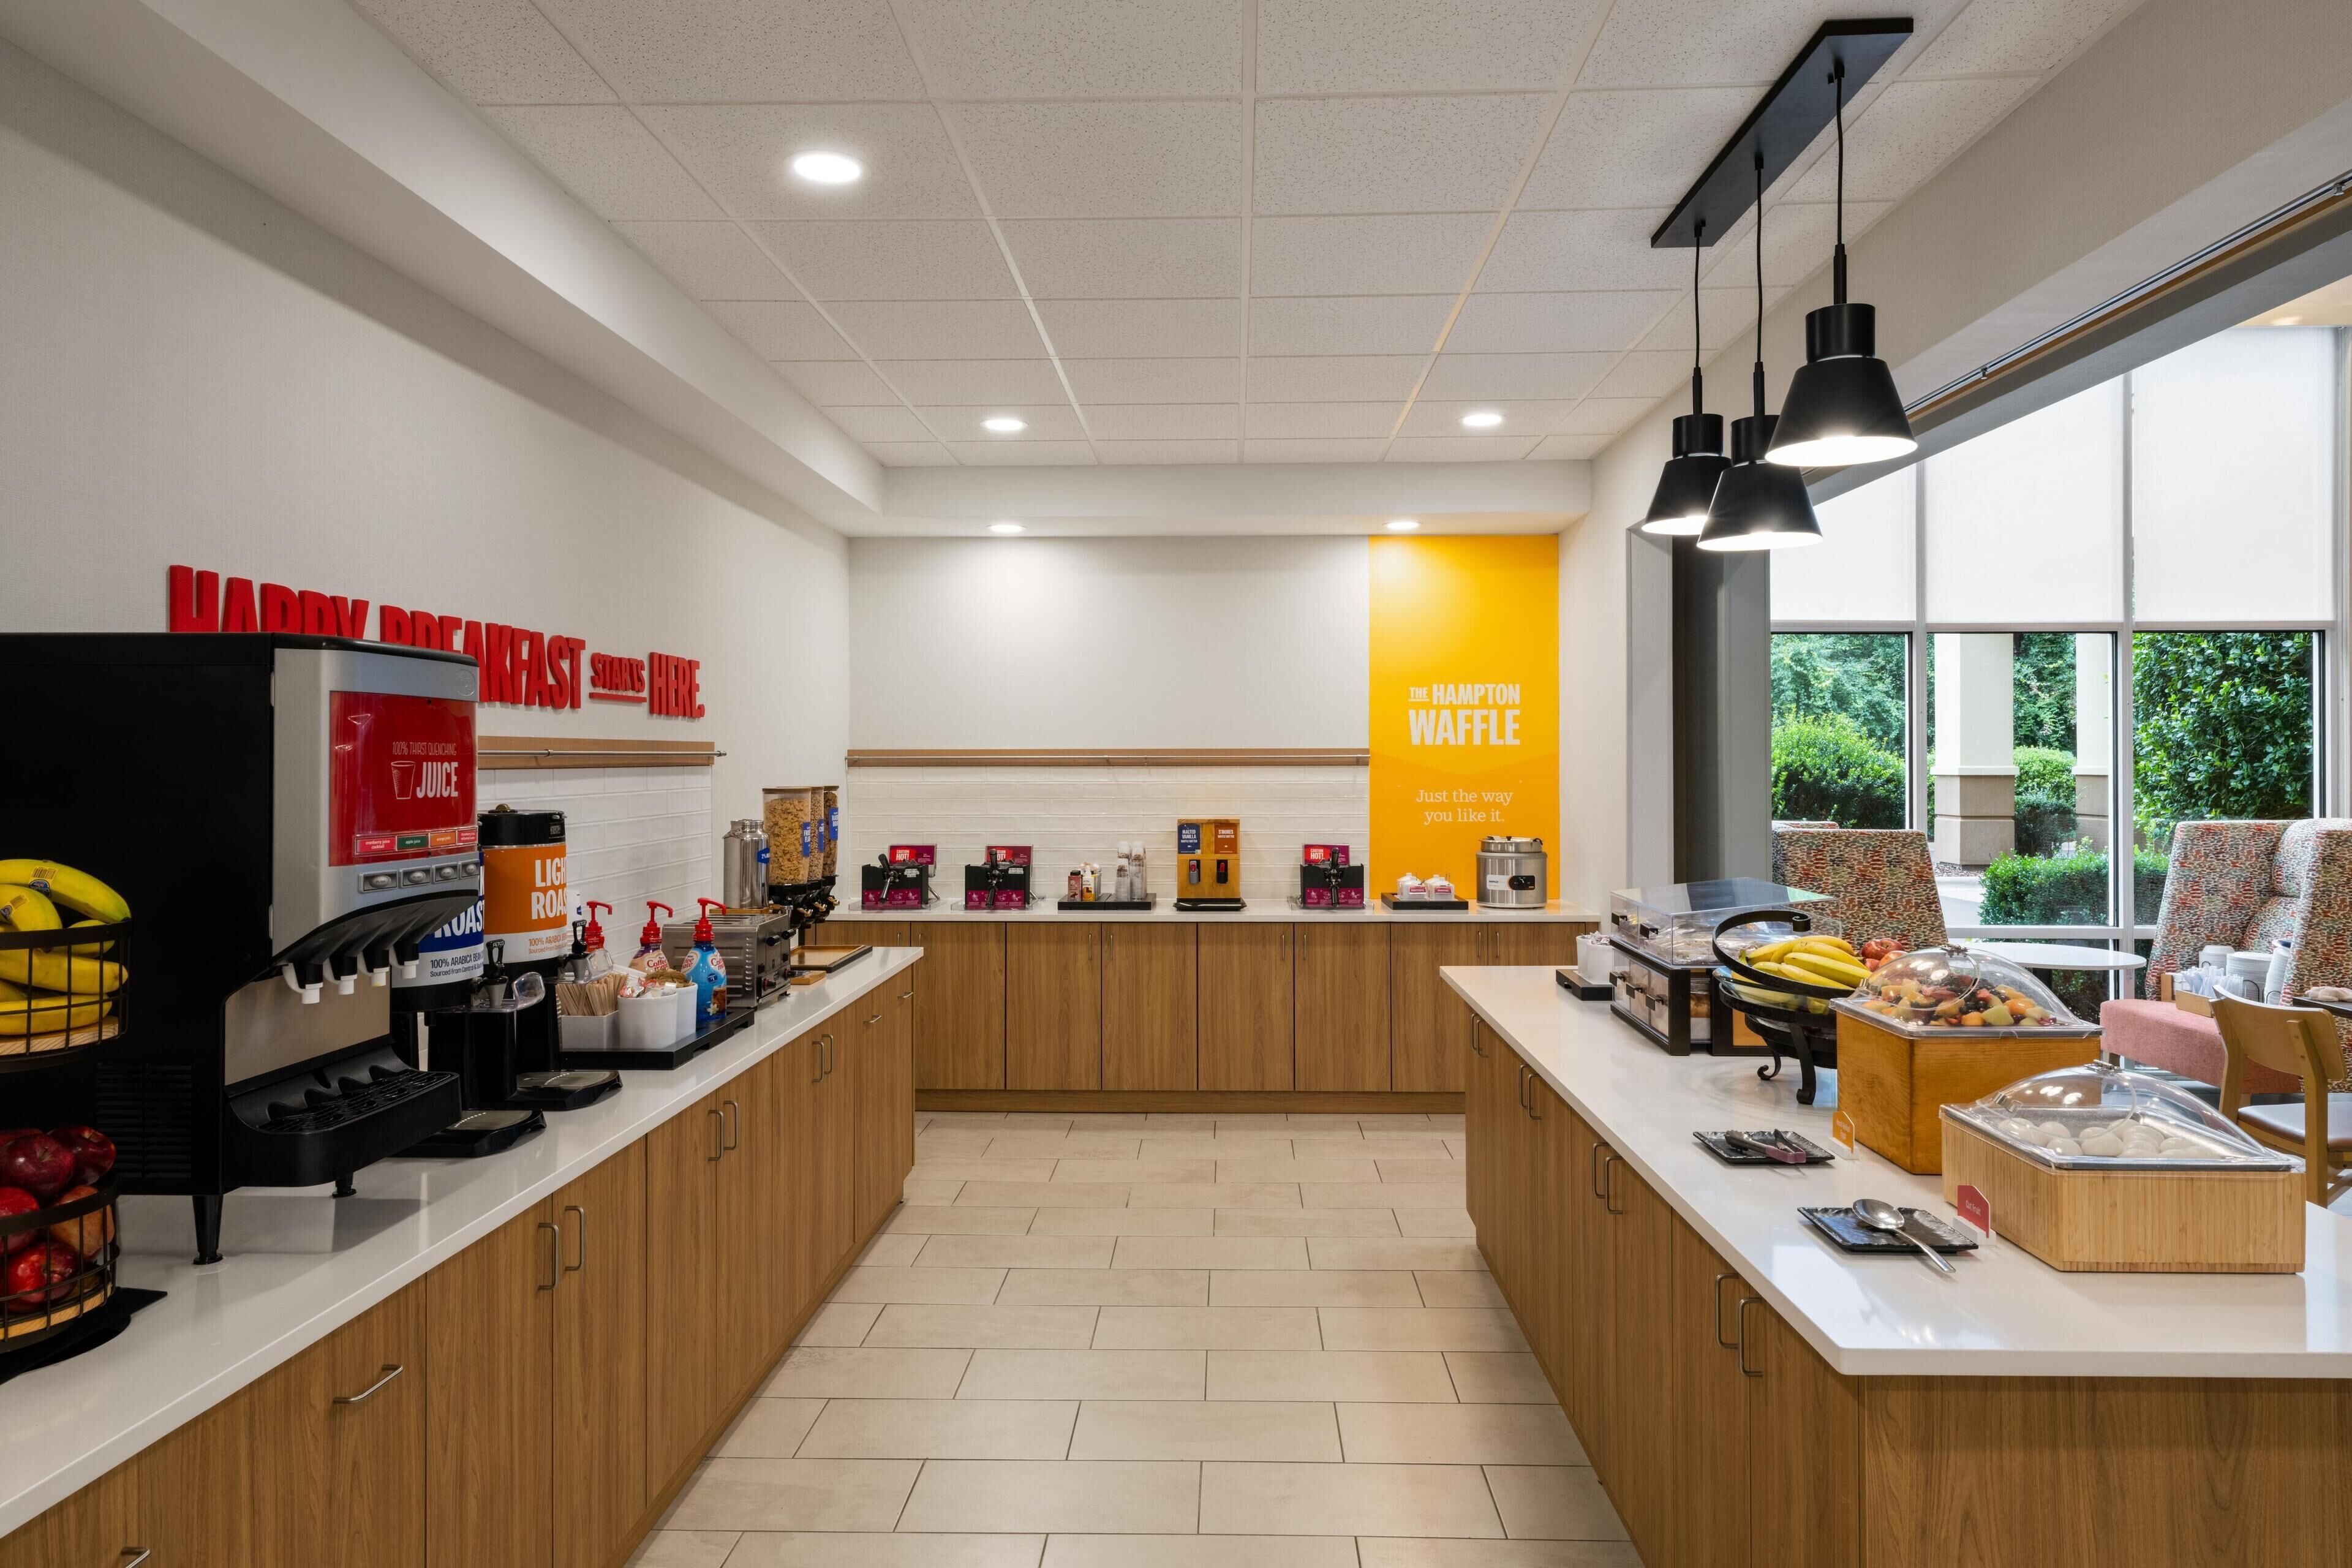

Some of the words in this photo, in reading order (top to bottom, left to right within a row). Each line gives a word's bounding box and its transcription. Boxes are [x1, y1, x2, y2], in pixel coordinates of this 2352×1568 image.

[590, 652, 646, 693] STARTS
[649, 652, 706, 718] HERE.
[1409, 687, 1428, 699] THE
[1432, 684, 1520, 705] HAMPTON
[1408, 709, 1520, 745] WAFFLE
[392, 742, 409, 755] 100%
[409, 742, 427, 755] THIRST
[428, 742, 457, 756] QUENCHING
[417, 761, 459, 798] JUICE
[1415, 789, 1449, 802] Just
[1452, 788, 1477, 802] the
[1481, 792, 1513, 805] way
[1424, 811, 1453, 825] you
[1458, 808, 1486, 822] like
[1490, 809, 1505, 822] it.
[535, 857, 566, 888] LIGH
[531, 888, 567, 919] ROAS
[430, 958, 450, 969] 100%
[451, 954, 472, 966] ARABICA
[430, 968, 451, 977] Sourced
